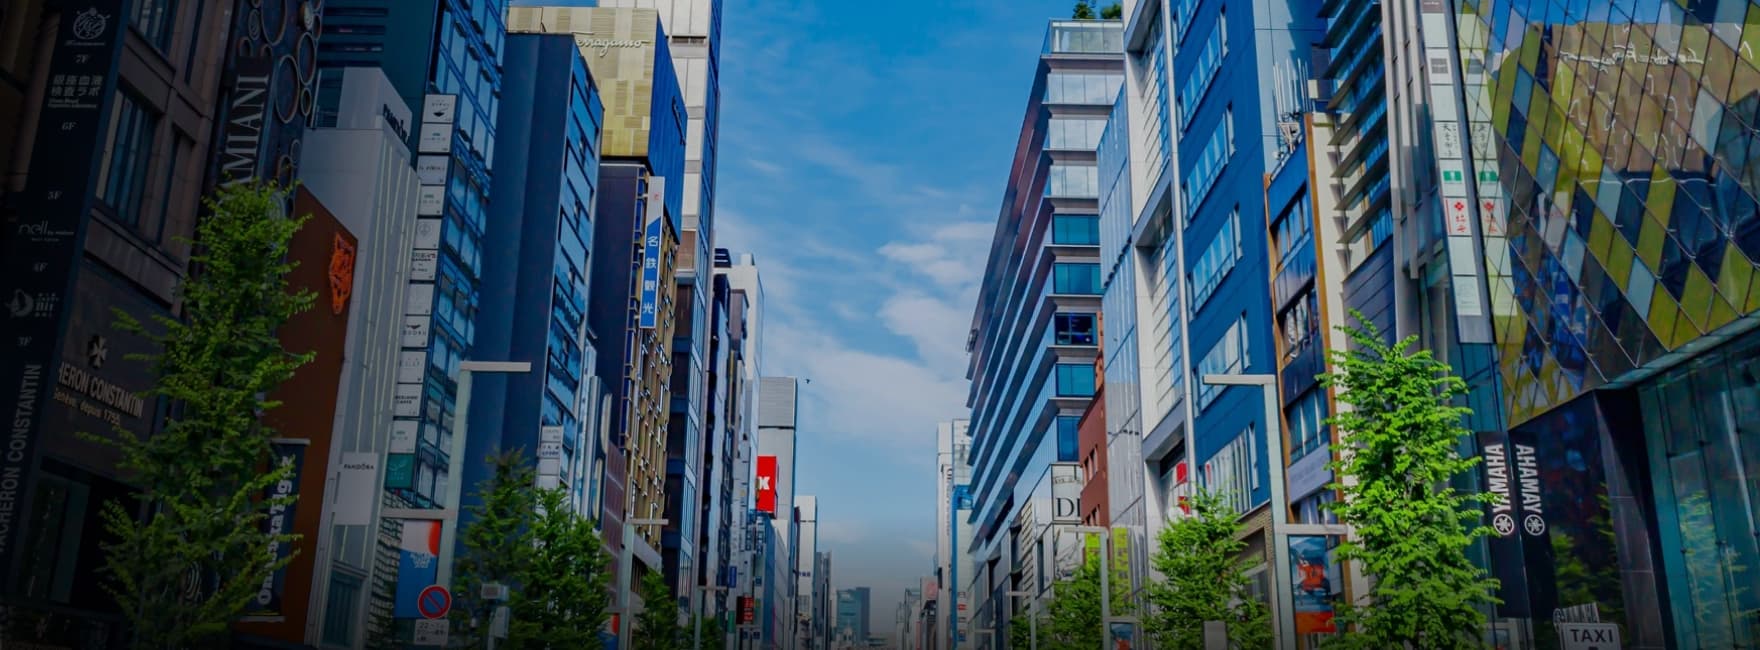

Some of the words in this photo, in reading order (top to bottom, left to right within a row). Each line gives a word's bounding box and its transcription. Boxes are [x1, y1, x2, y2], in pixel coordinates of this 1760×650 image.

[642, 235, 659, 314] 名鉄観光
[8, 364, 41, 462] CONSTANTIN
[90, 377, 144, 416] CONSTANTIN
[1569, 629, 1614, 643] TAXI
